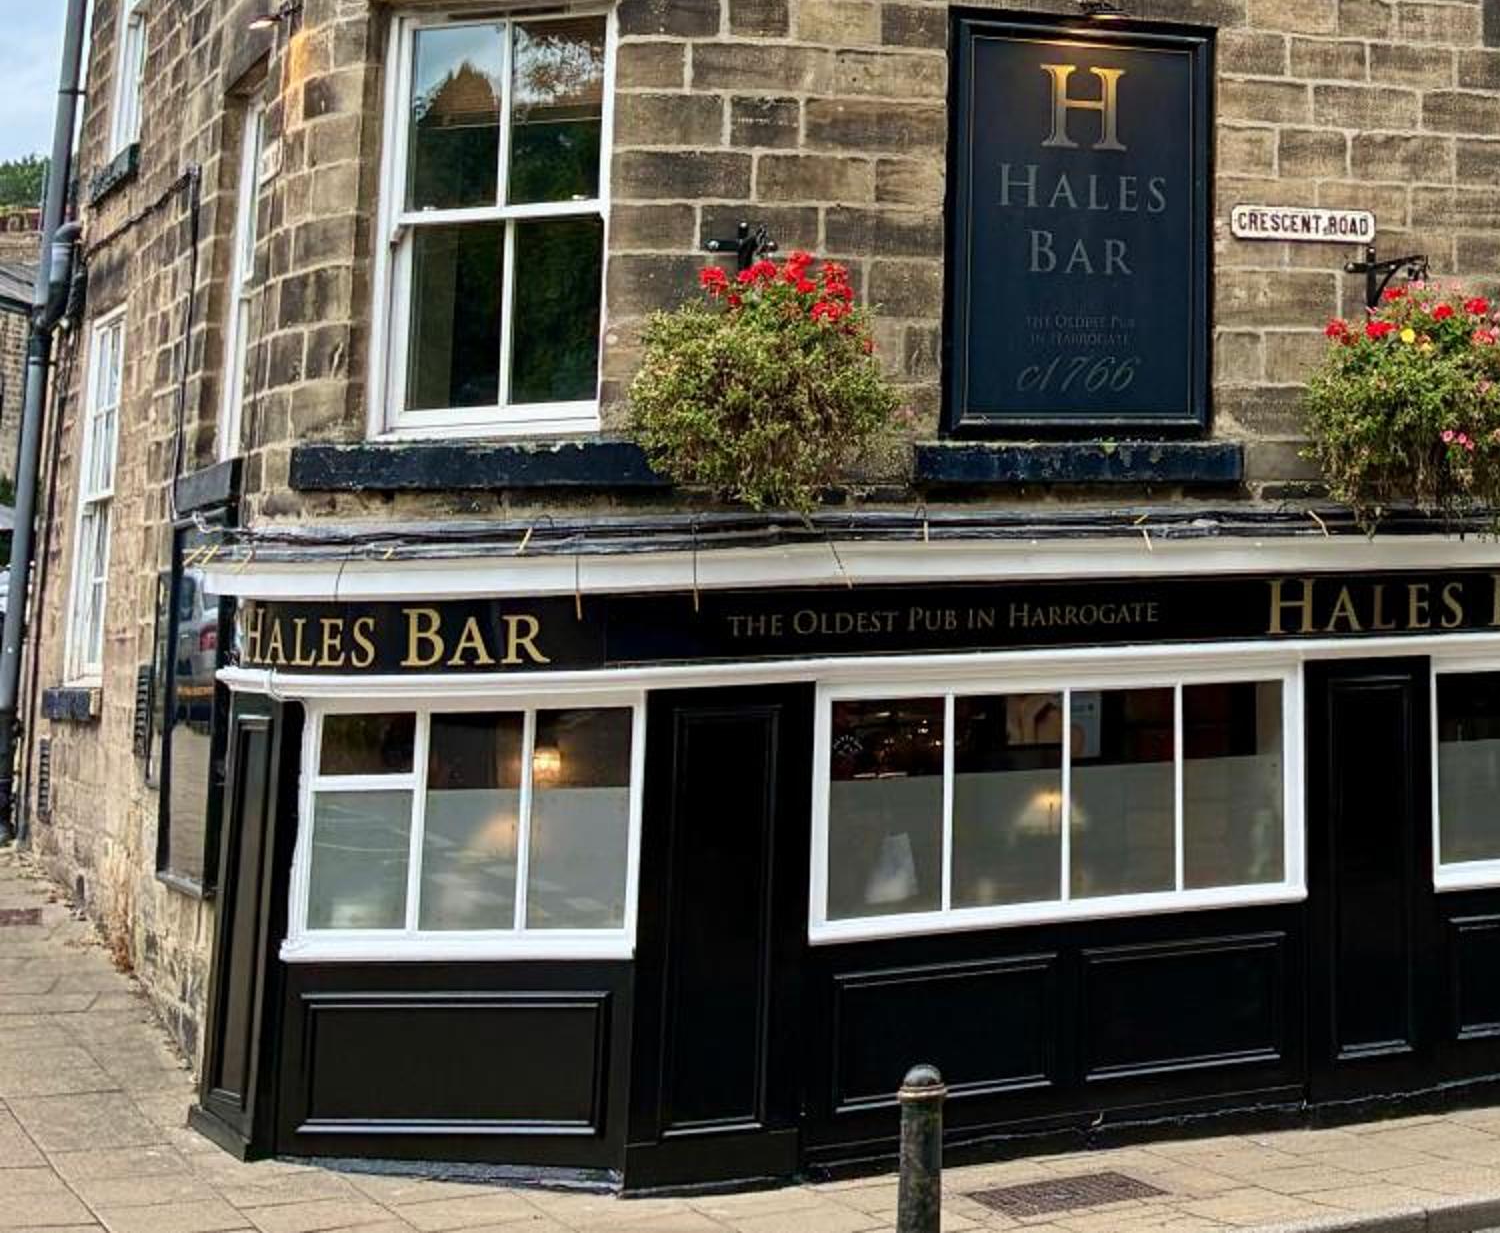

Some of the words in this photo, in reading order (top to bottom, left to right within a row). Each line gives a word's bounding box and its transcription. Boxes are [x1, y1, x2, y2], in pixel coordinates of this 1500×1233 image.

[1040, 63, 1127, 151] H
[998, 162, 1167, 214] HALES
[1237, 212, 1323, 234] CRESCENT
[1327, 214, 1369, 236] ROAD
[1027, 228, 1133, 276] BAR
[726, 614, 785, 638] THE
[793, 609, 899, 634] OLDEST
[906, 606, 958, 631] PUB
[967, 606, 995, 630] IN
[1008, 601, 1160, 629] HARROGATE
[1264, 577, 1464, 635] HALES
[243, 607, 376, 668] HALES
[399, 607, 551, 667] BAR
